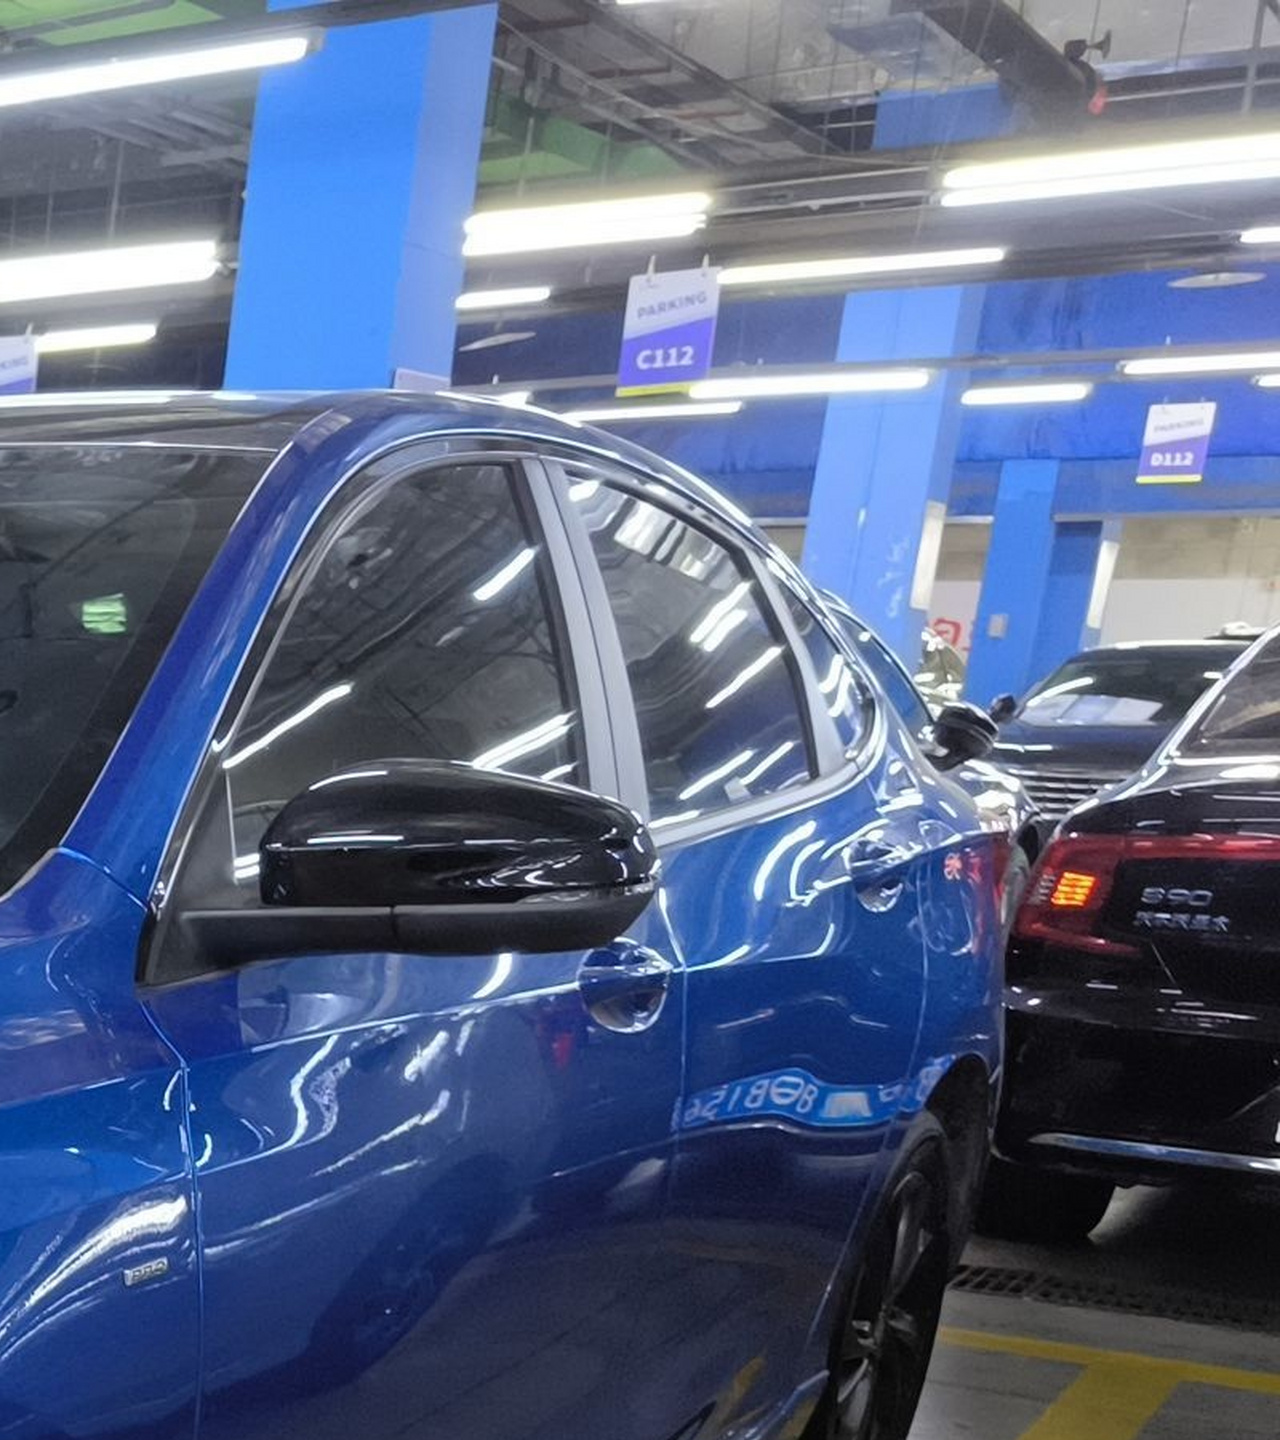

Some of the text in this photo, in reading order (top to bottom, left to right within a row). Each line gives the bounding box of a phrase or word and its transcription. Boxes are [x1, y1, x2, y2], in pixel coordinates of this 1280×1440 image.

[636, 291, 708, 319] PARKING
[635, 345, 695, 370] C112
[1150, 452, 1194, 467] D112
